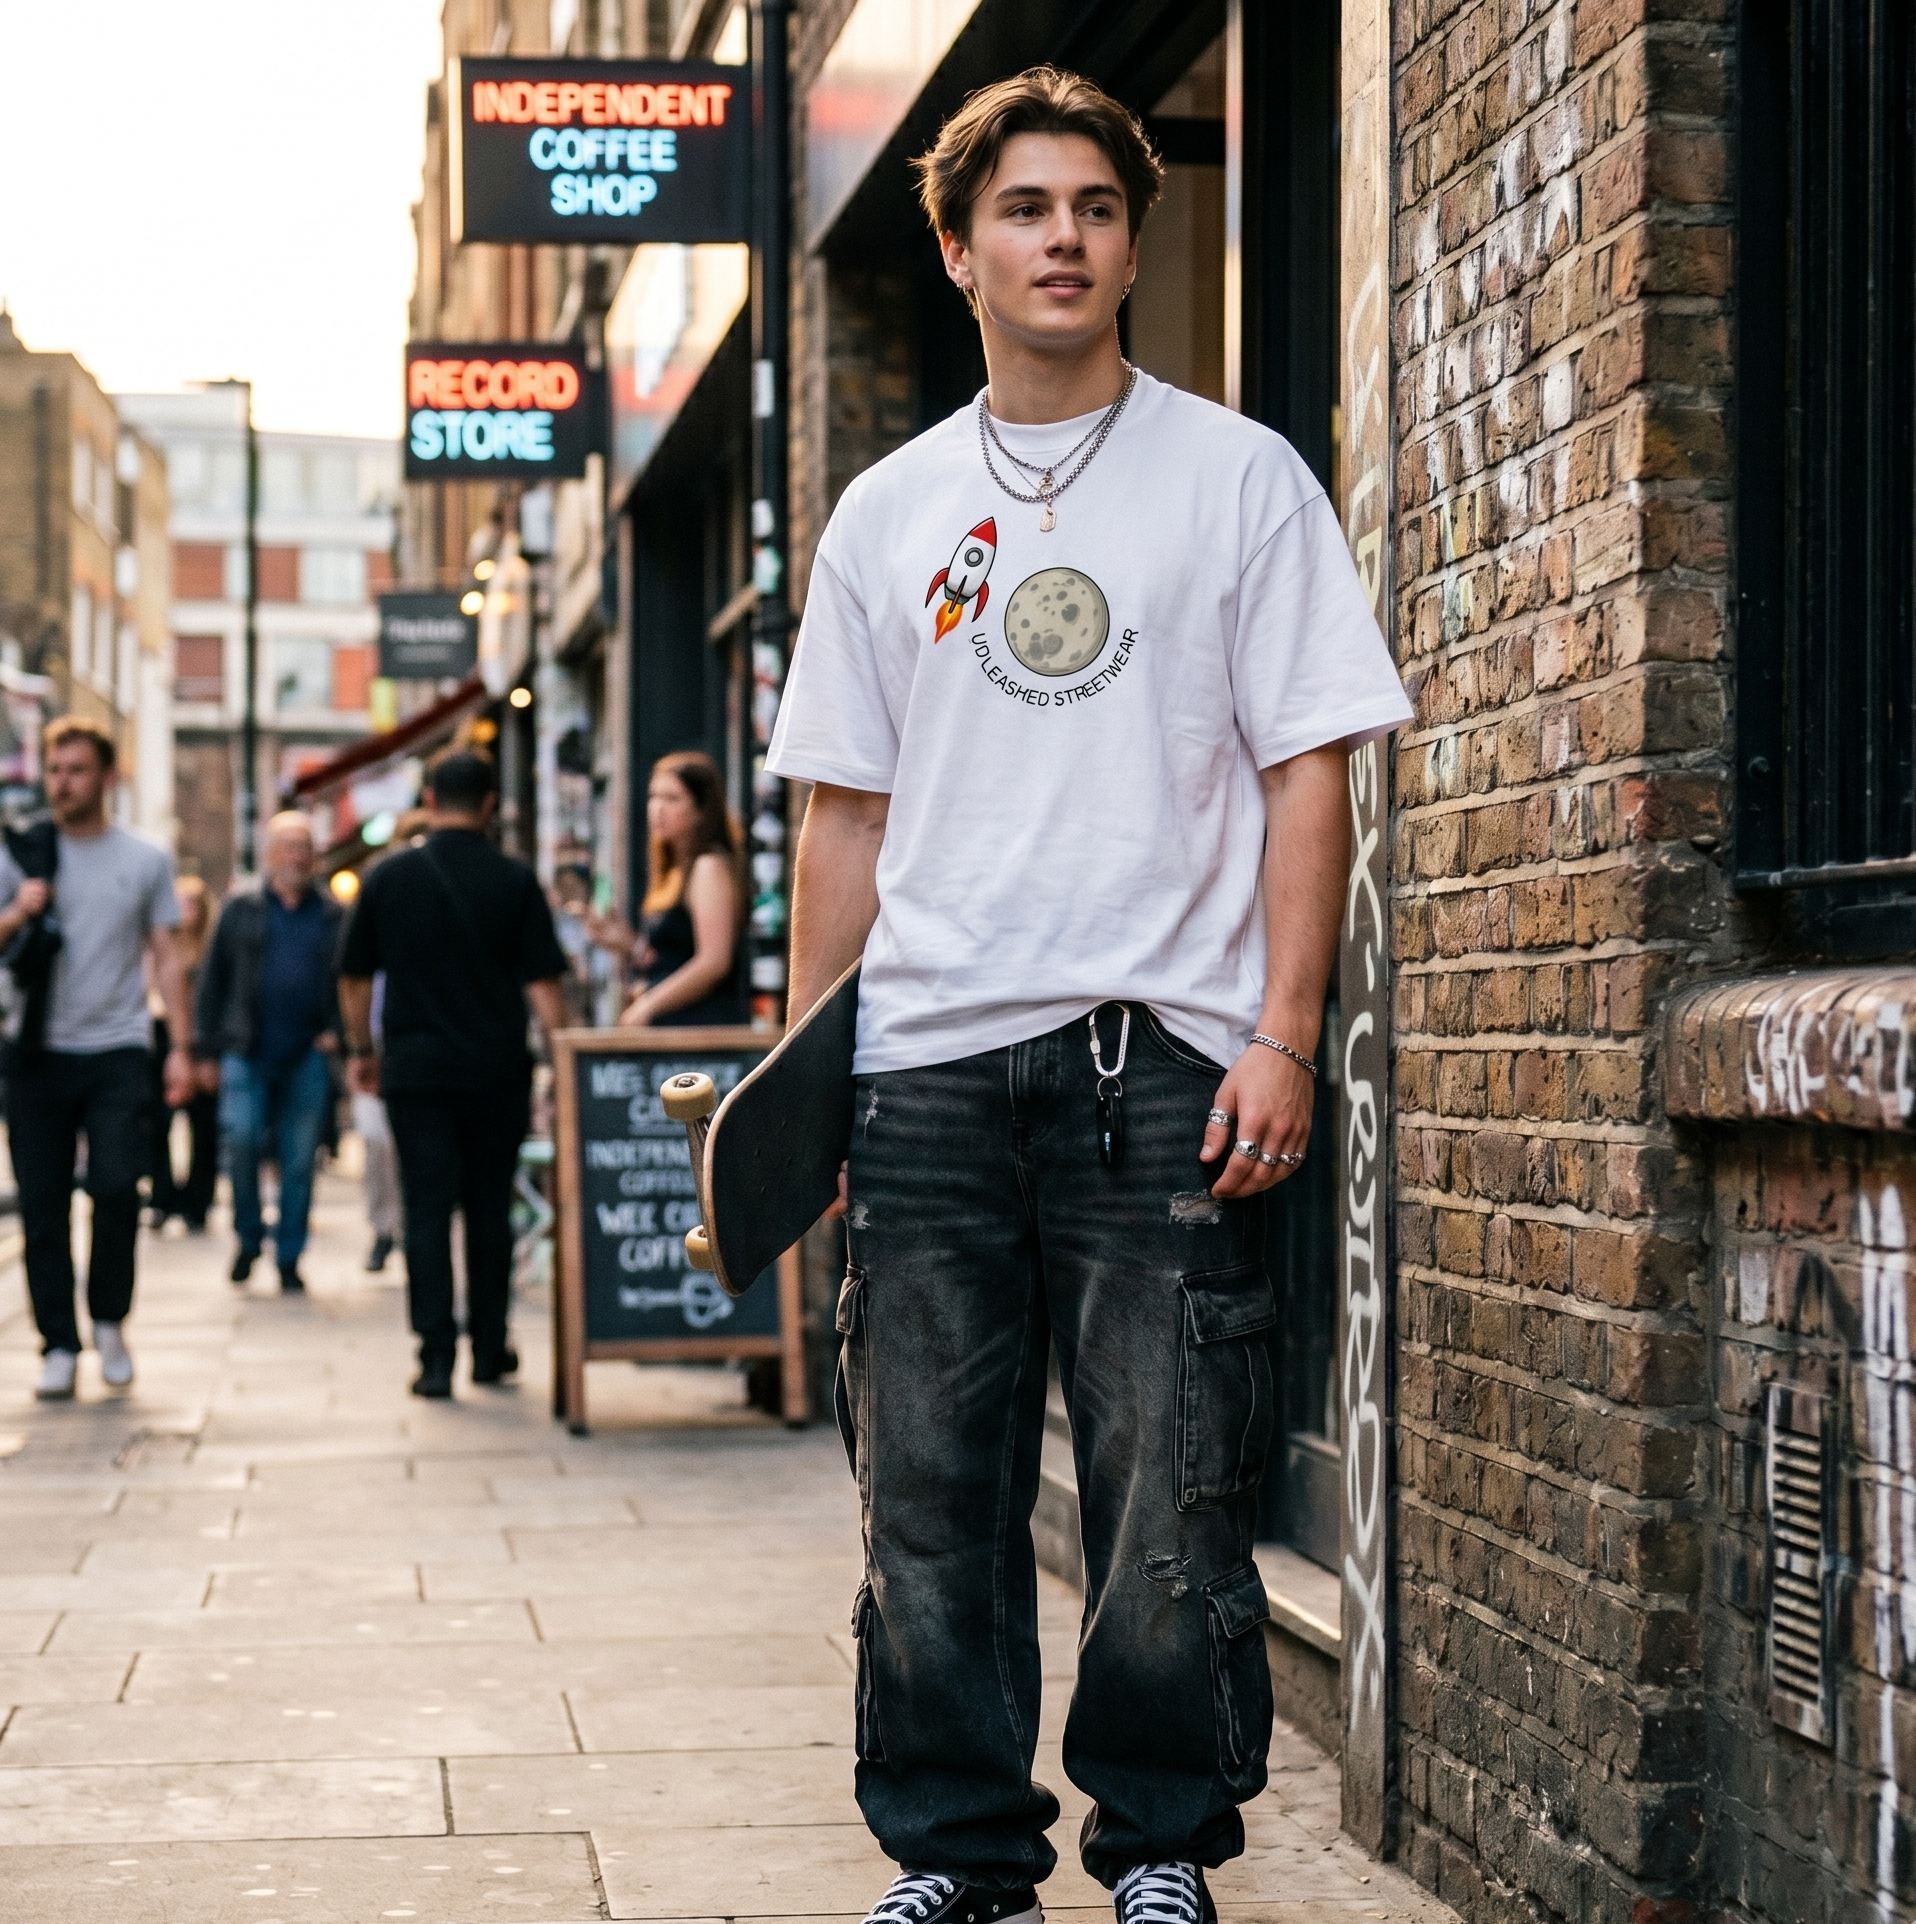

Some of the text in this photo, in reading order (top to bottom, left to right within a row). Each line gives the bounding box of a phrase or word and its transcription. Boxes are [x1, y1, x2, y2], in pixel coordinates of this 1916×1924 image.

[473, 81, 731, 126] INDEPENDENT
[529, 127, 677, 171] COFFEE
[551, 173, 657, 216] SHOP
[409, 360, 579, 410] RECORD
[411, 410, 555, 461] STORE
[971, 628, 1139, 707] UDLEASHED STREETWEAR
